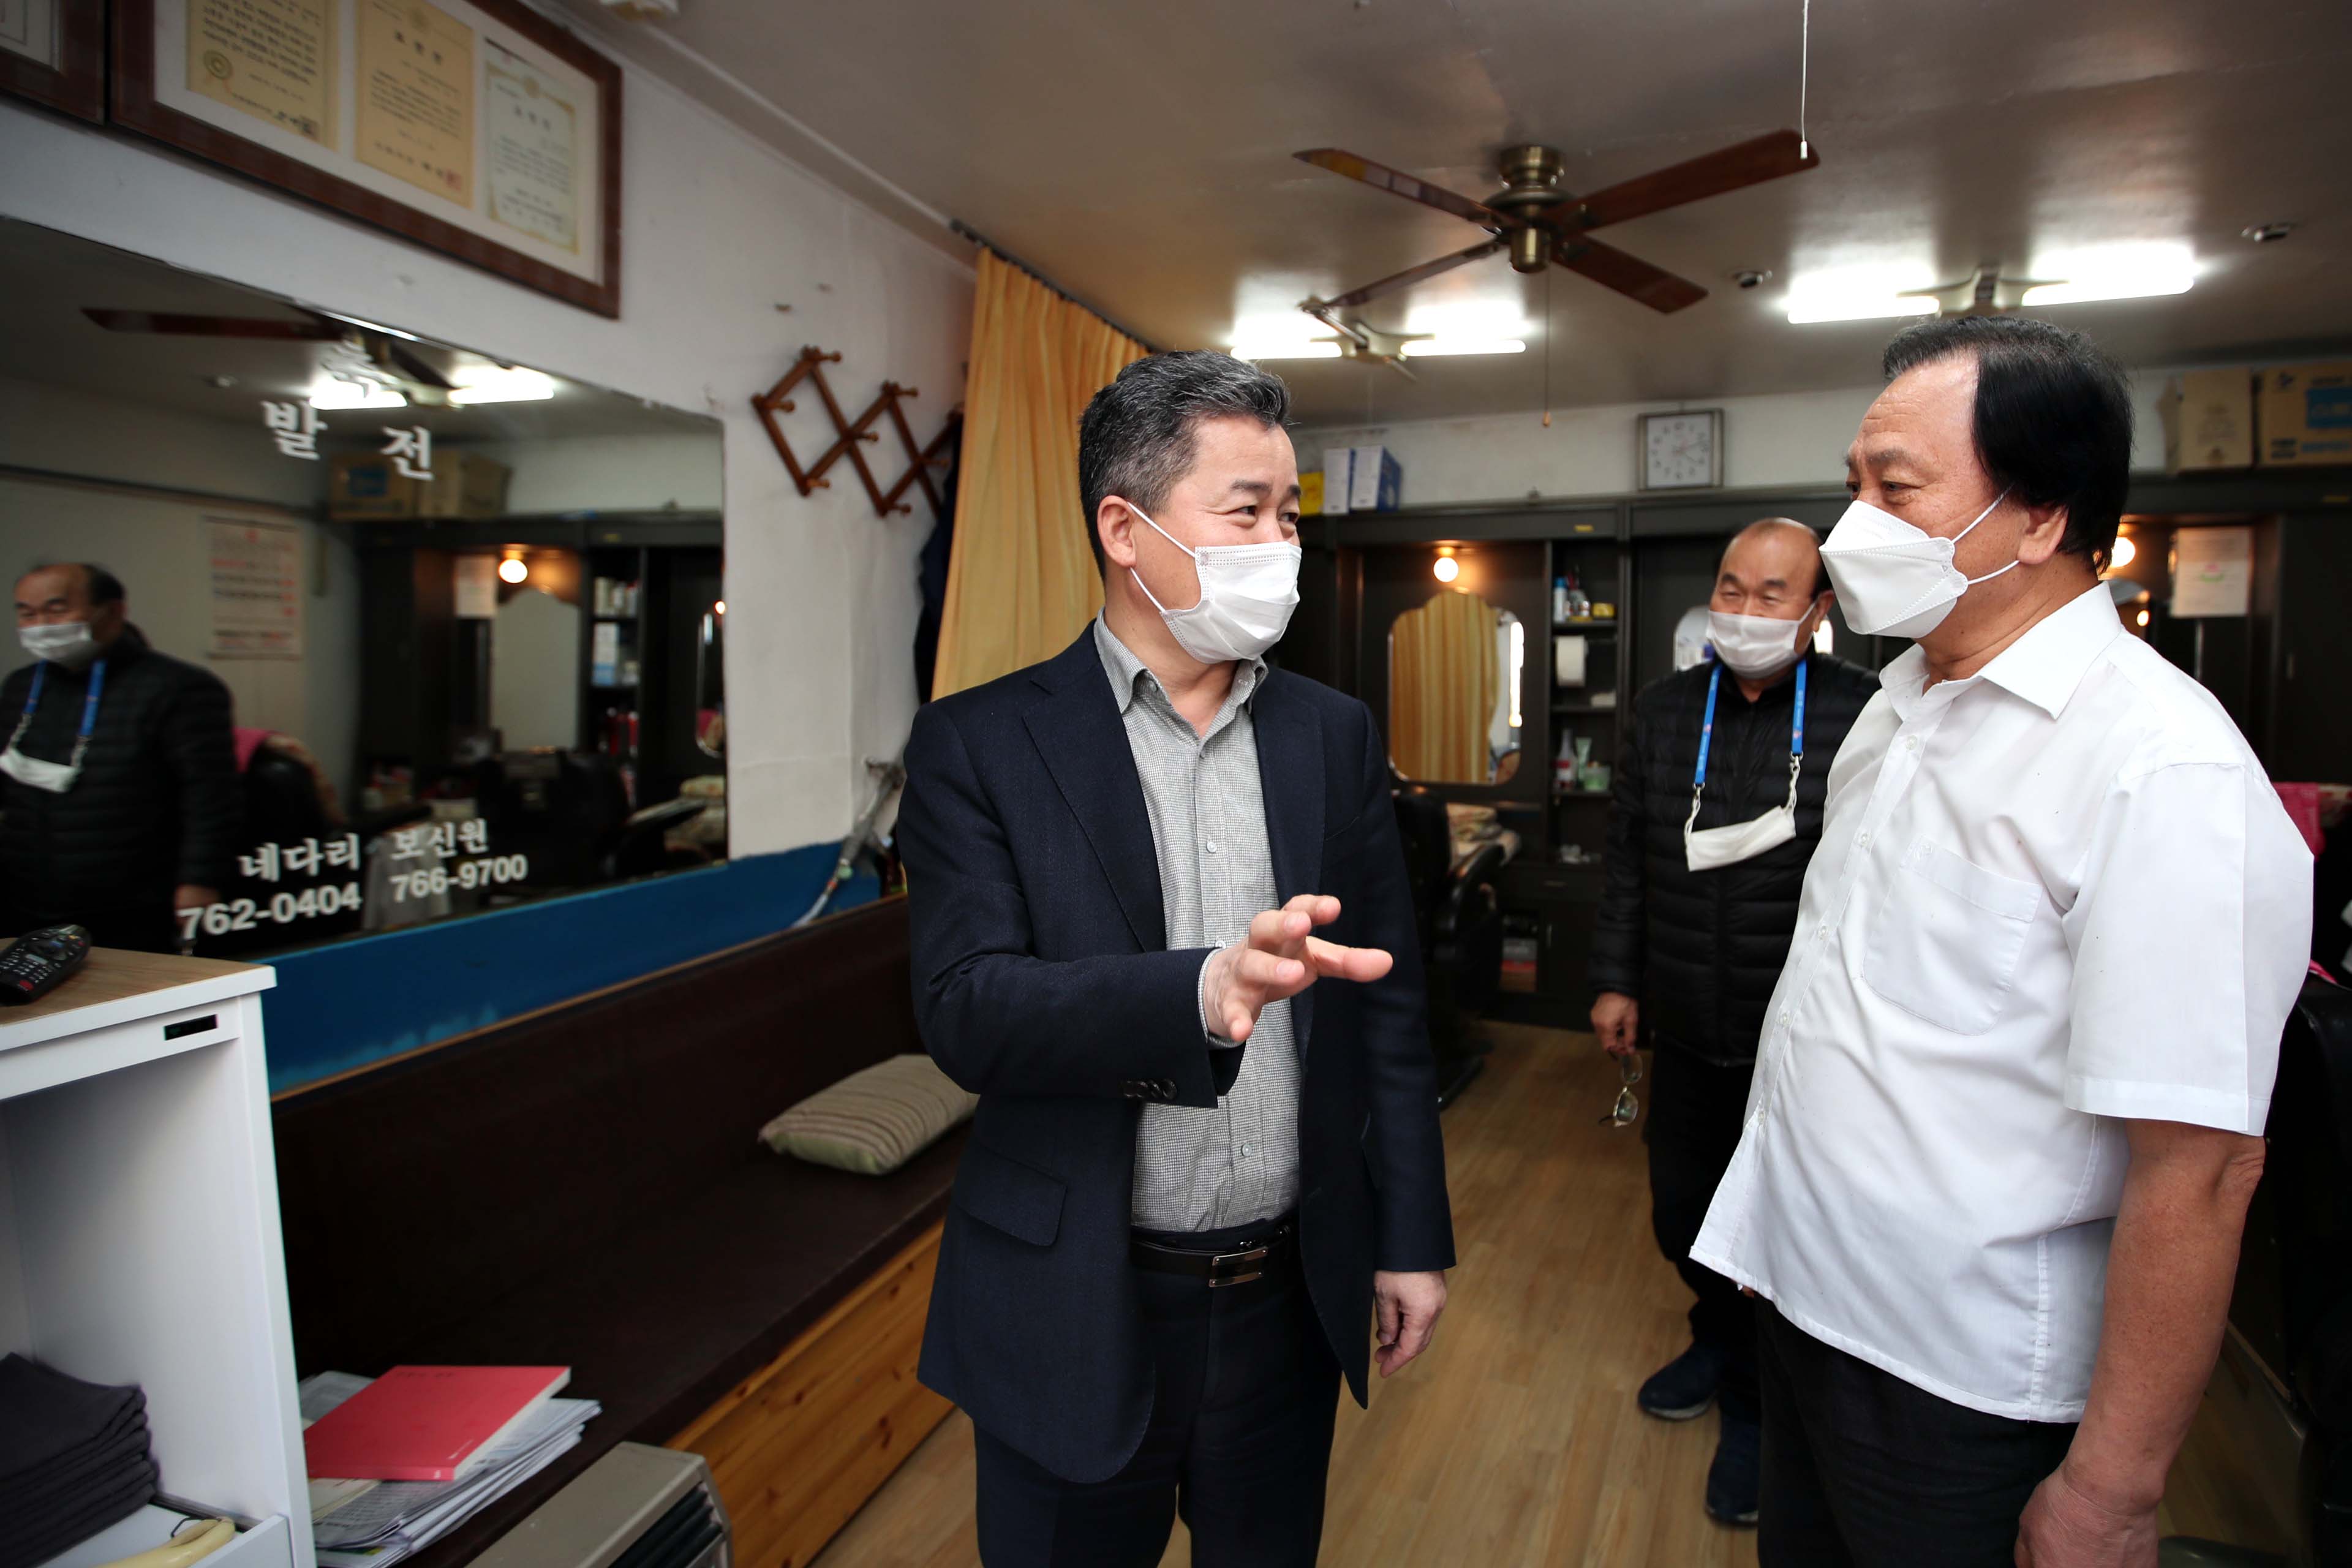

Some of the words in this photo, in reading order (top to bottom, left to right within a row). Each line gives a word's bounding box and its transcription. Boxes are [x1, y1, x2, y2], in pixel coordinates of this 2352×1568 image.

[238, 832, 360, 882] 네다리
[389, 818, 489, 861] 보신원
[177, 881, 363, 940] 762-0404
[390, 855, 528, 902] 766-9700
